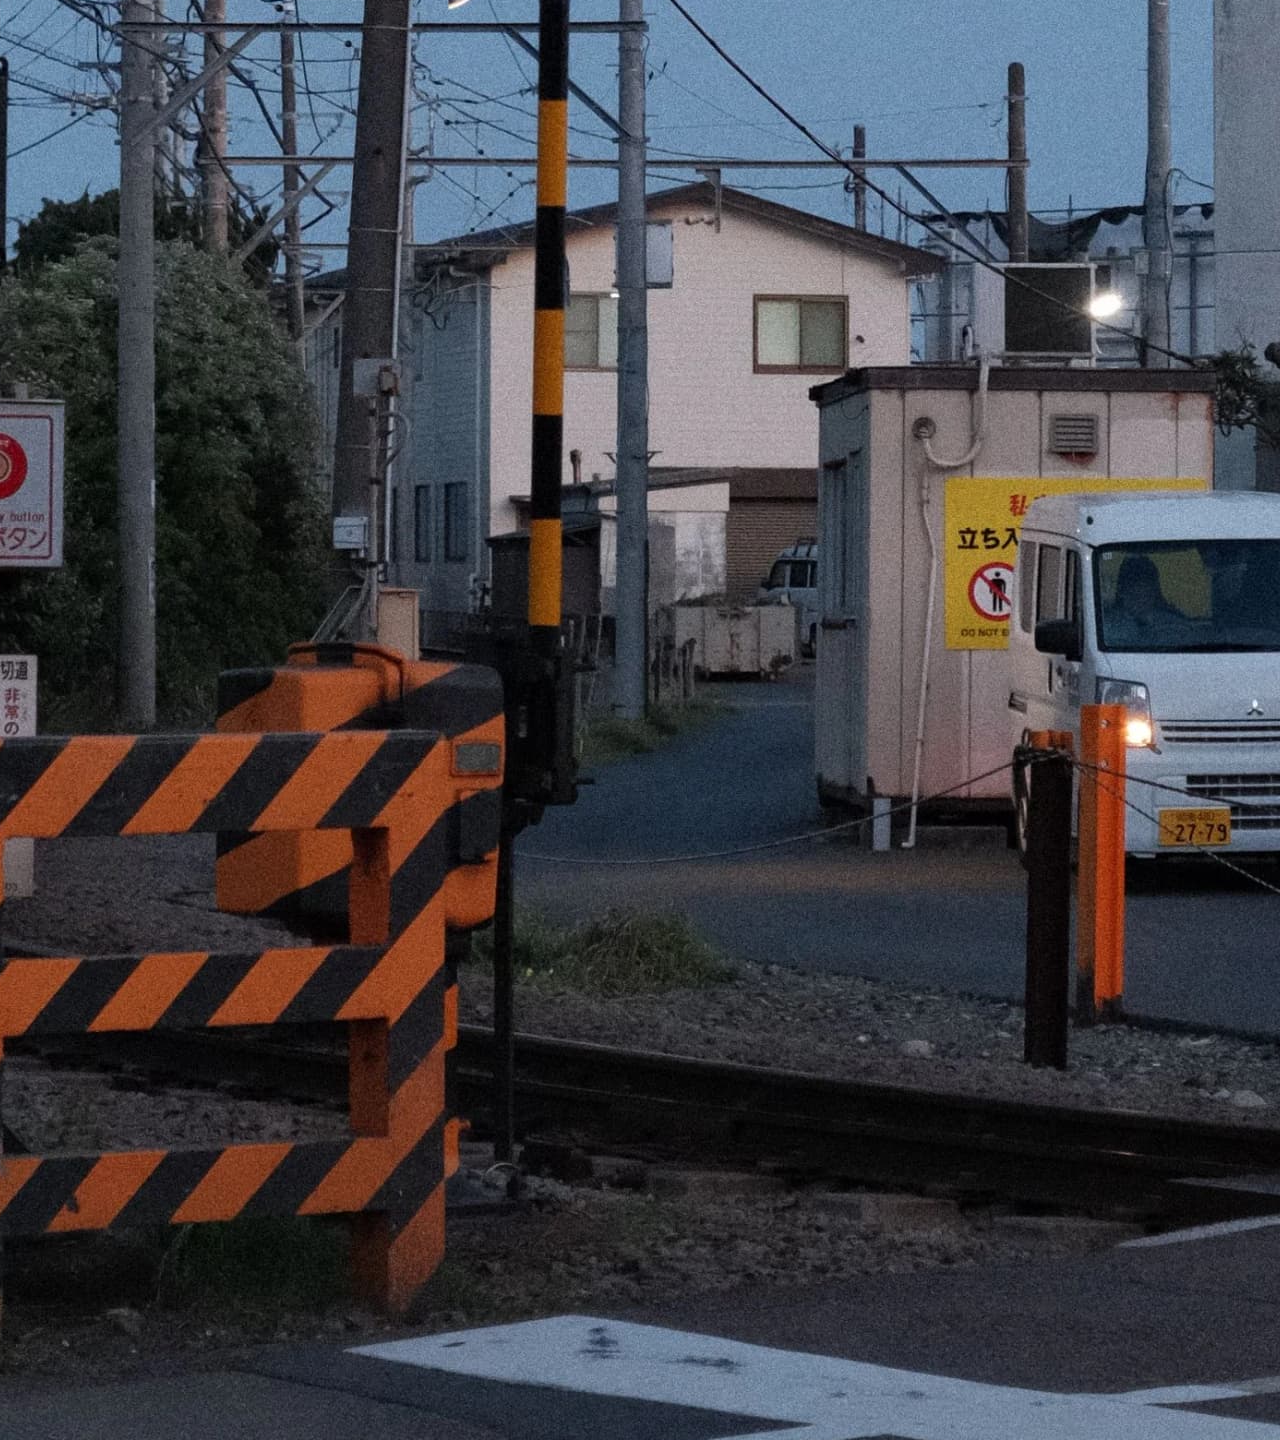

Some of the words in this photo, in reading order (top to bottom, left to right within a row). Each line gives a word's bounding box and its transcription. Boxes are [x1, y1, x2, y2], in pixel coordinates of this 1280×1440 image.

[10, 511, 45, 522] button
[960, 628, 976, 638] DO
[978, 628, 998, 637] NOT
